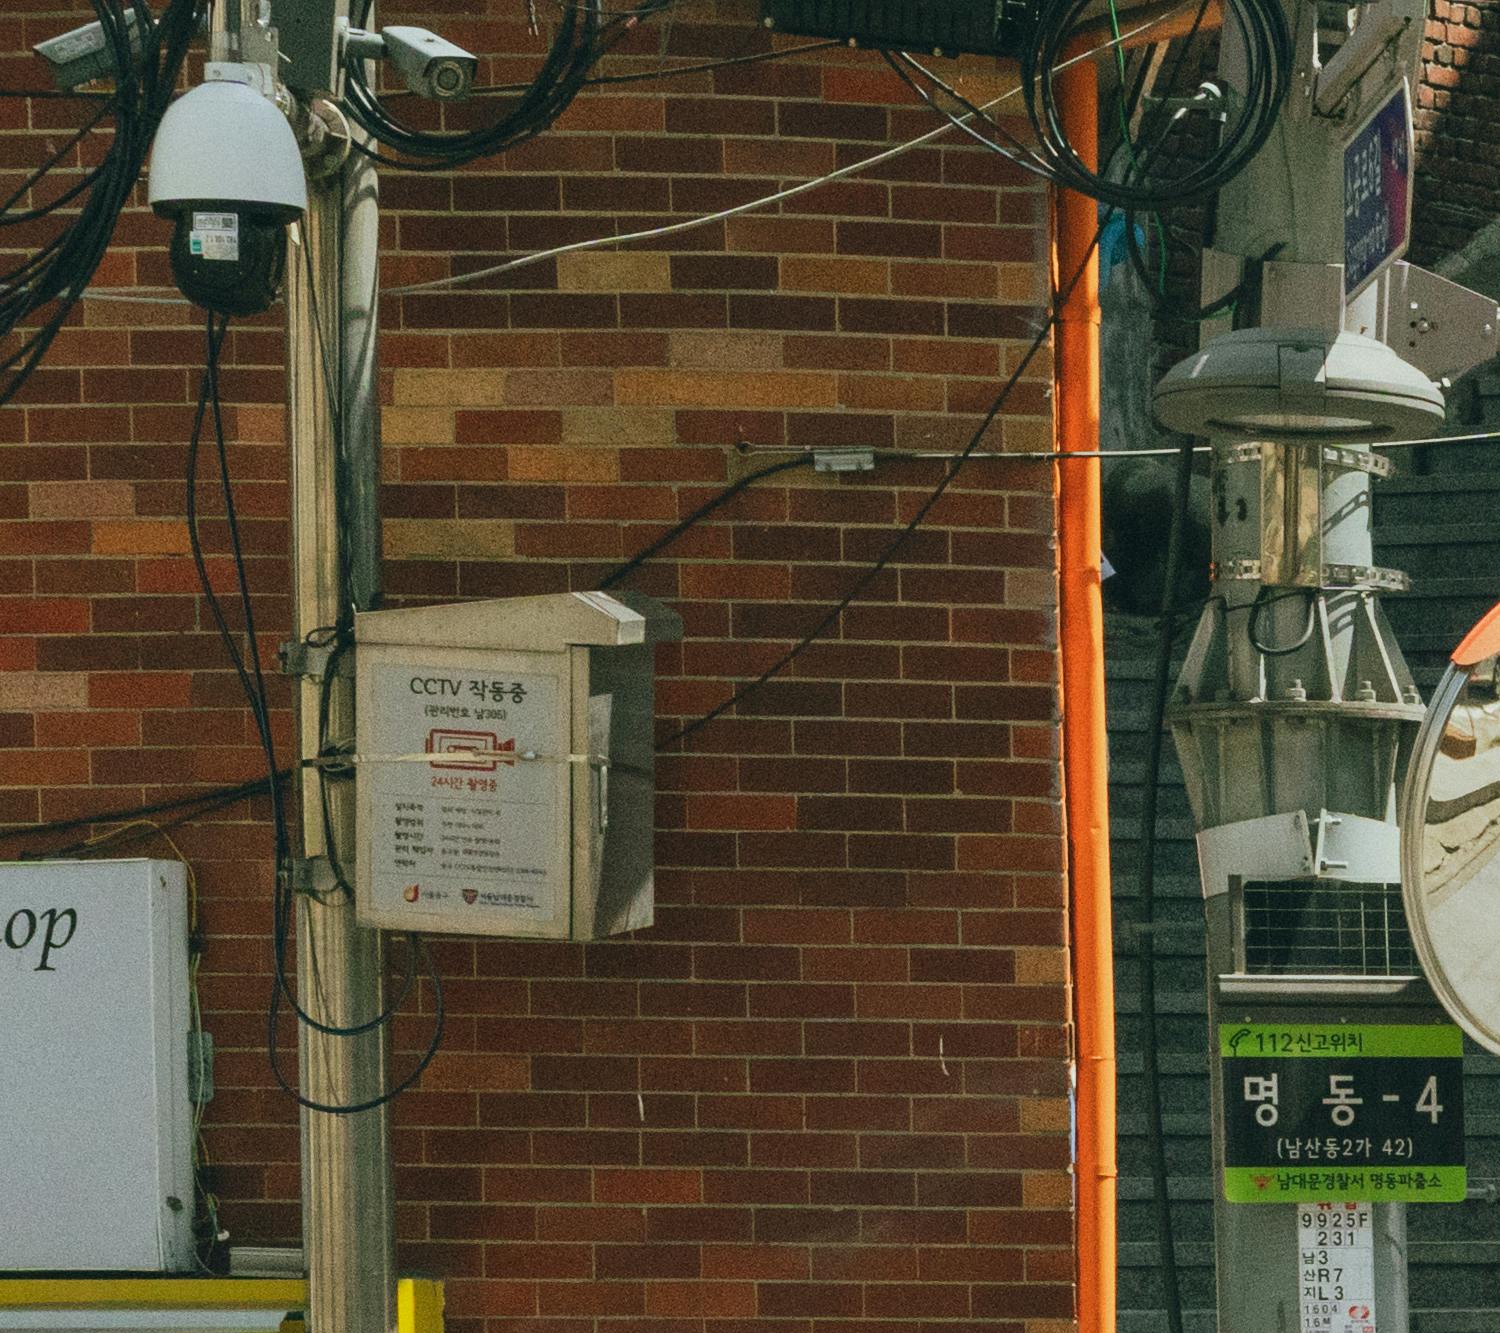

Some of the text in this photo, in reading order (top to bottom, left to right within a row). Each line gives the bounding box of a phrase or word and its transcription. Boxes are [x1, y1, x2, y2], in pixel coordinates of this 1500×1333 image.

[410, 677, 527, 704] CCTV 작동중
[0, 906, 78, 971] op
[1255, 1032, 1363, 1052] 112신고위치
[1277, 1138, 1413, 1159] (남산동2가 42)
[1277, 1171, 1442, 1190] 남대문경찰서 명동파출소
